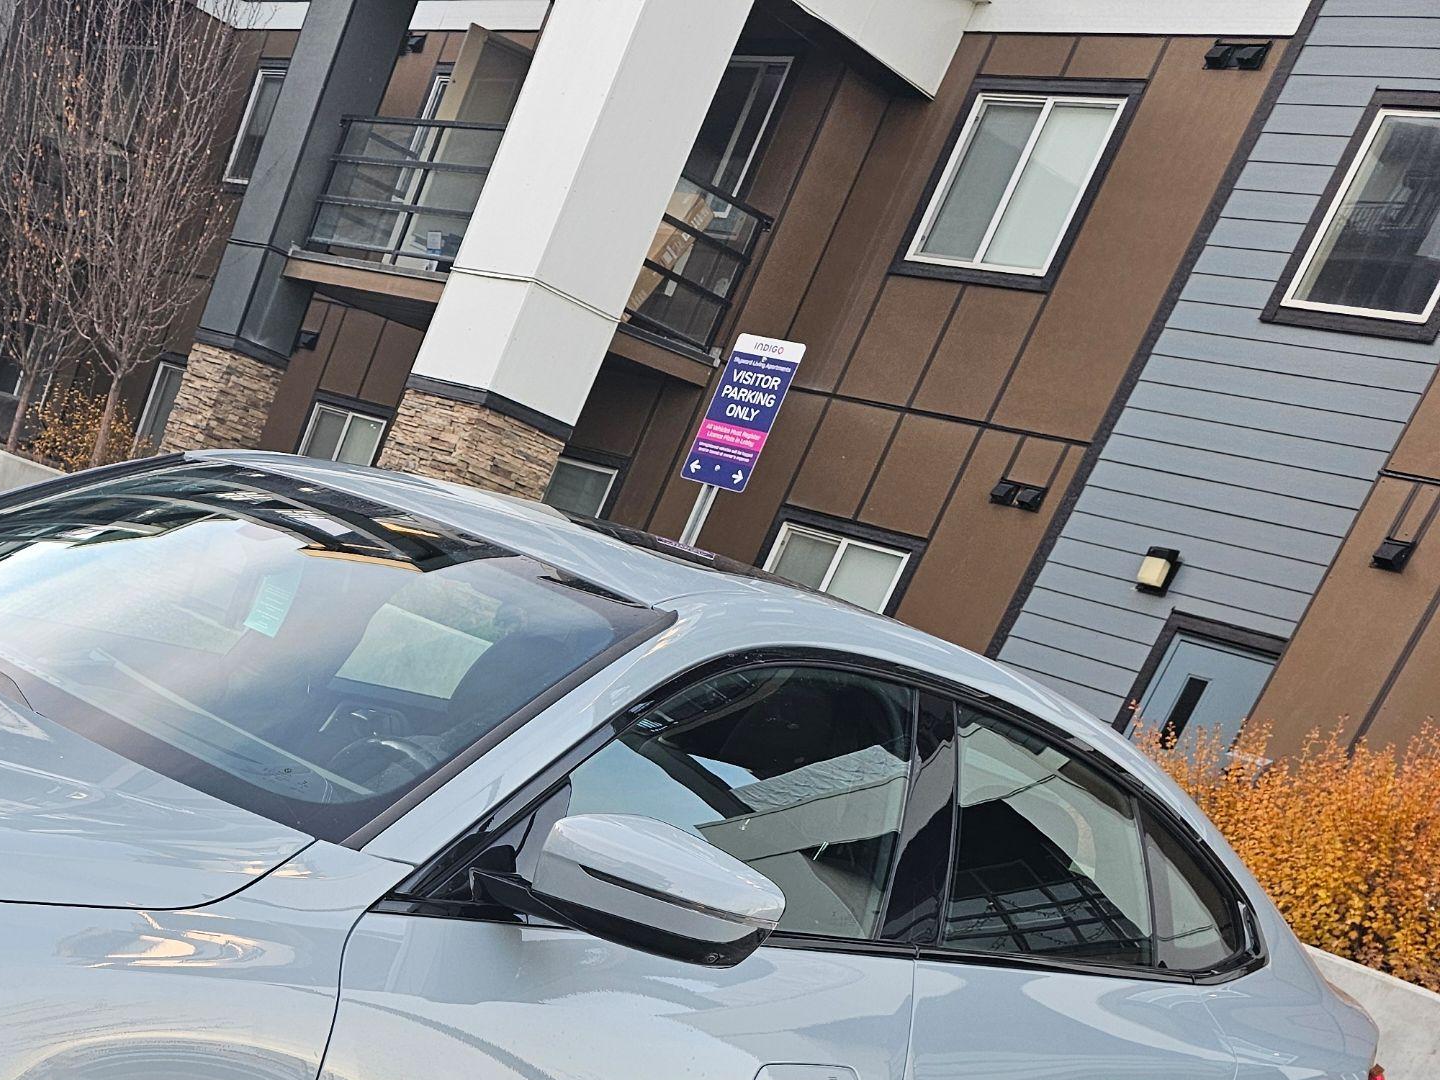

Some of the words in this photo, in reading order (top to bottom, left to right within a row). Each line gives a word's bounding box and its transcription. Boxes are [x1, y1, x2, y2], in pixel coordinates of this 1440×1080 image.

[754, 342, 784, 355] INDIGO
[733, 369, 781, 390] VISITOR
[721, 384, 776, 407] PARKING
[726, 403, 760, 421] ONLY
